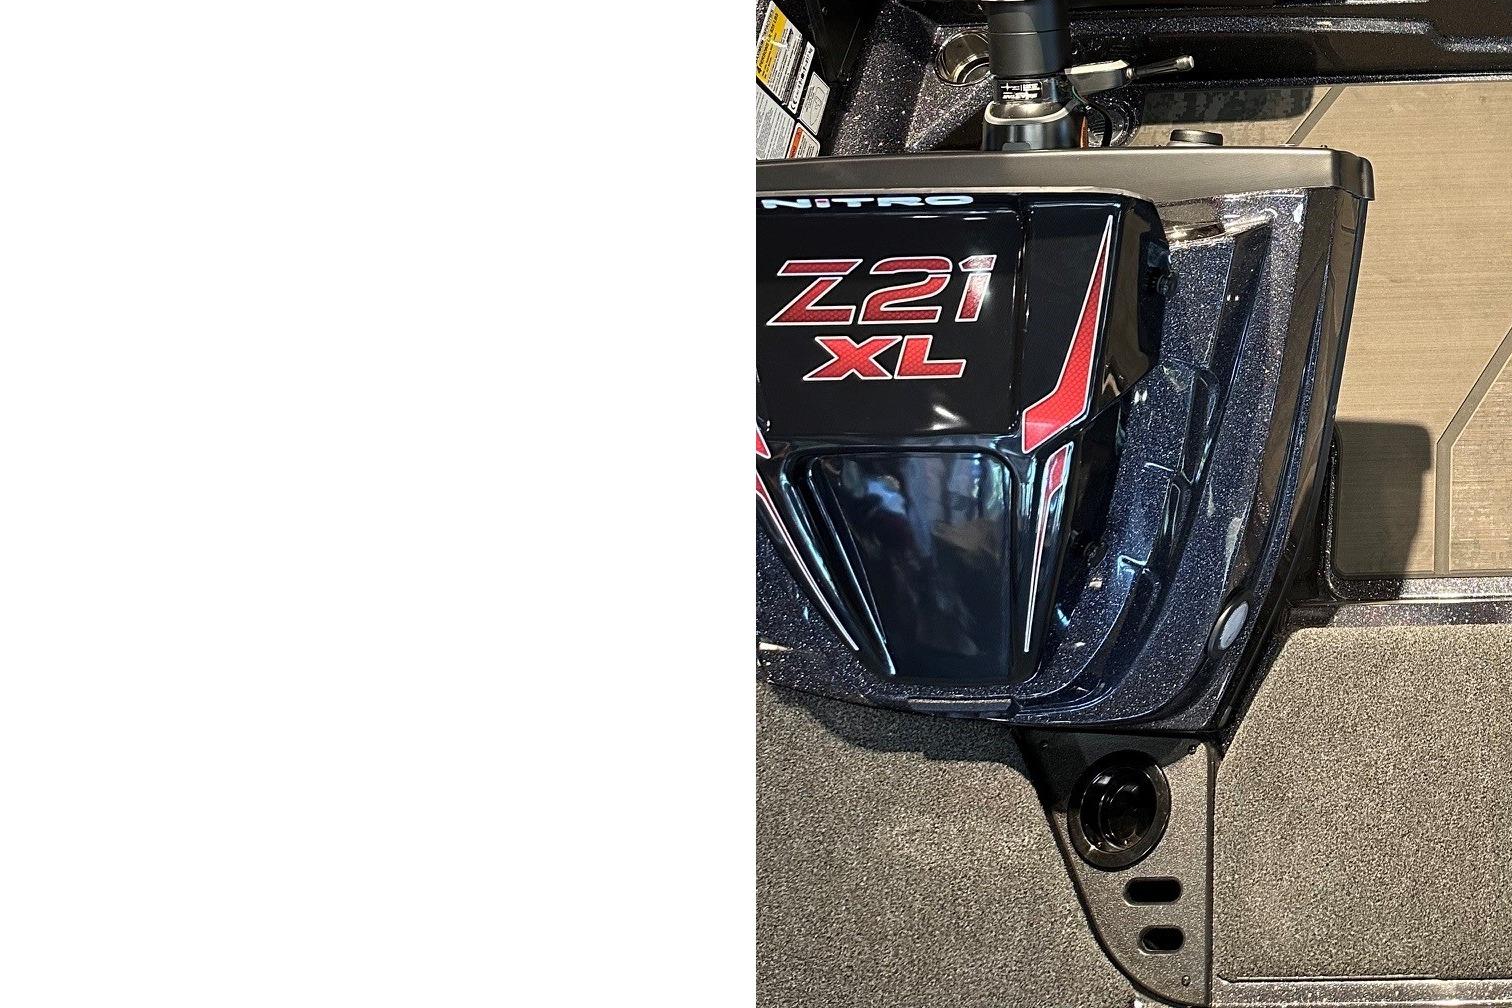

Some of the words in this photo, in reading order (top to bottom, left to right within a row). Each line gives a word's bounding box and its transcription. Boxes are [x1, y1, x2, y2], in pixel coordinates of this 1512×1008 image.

[761, 195, 974, 210] NITRO
[766, 254, 998, 326] Z21
[802, 334, 967, 381] XL
